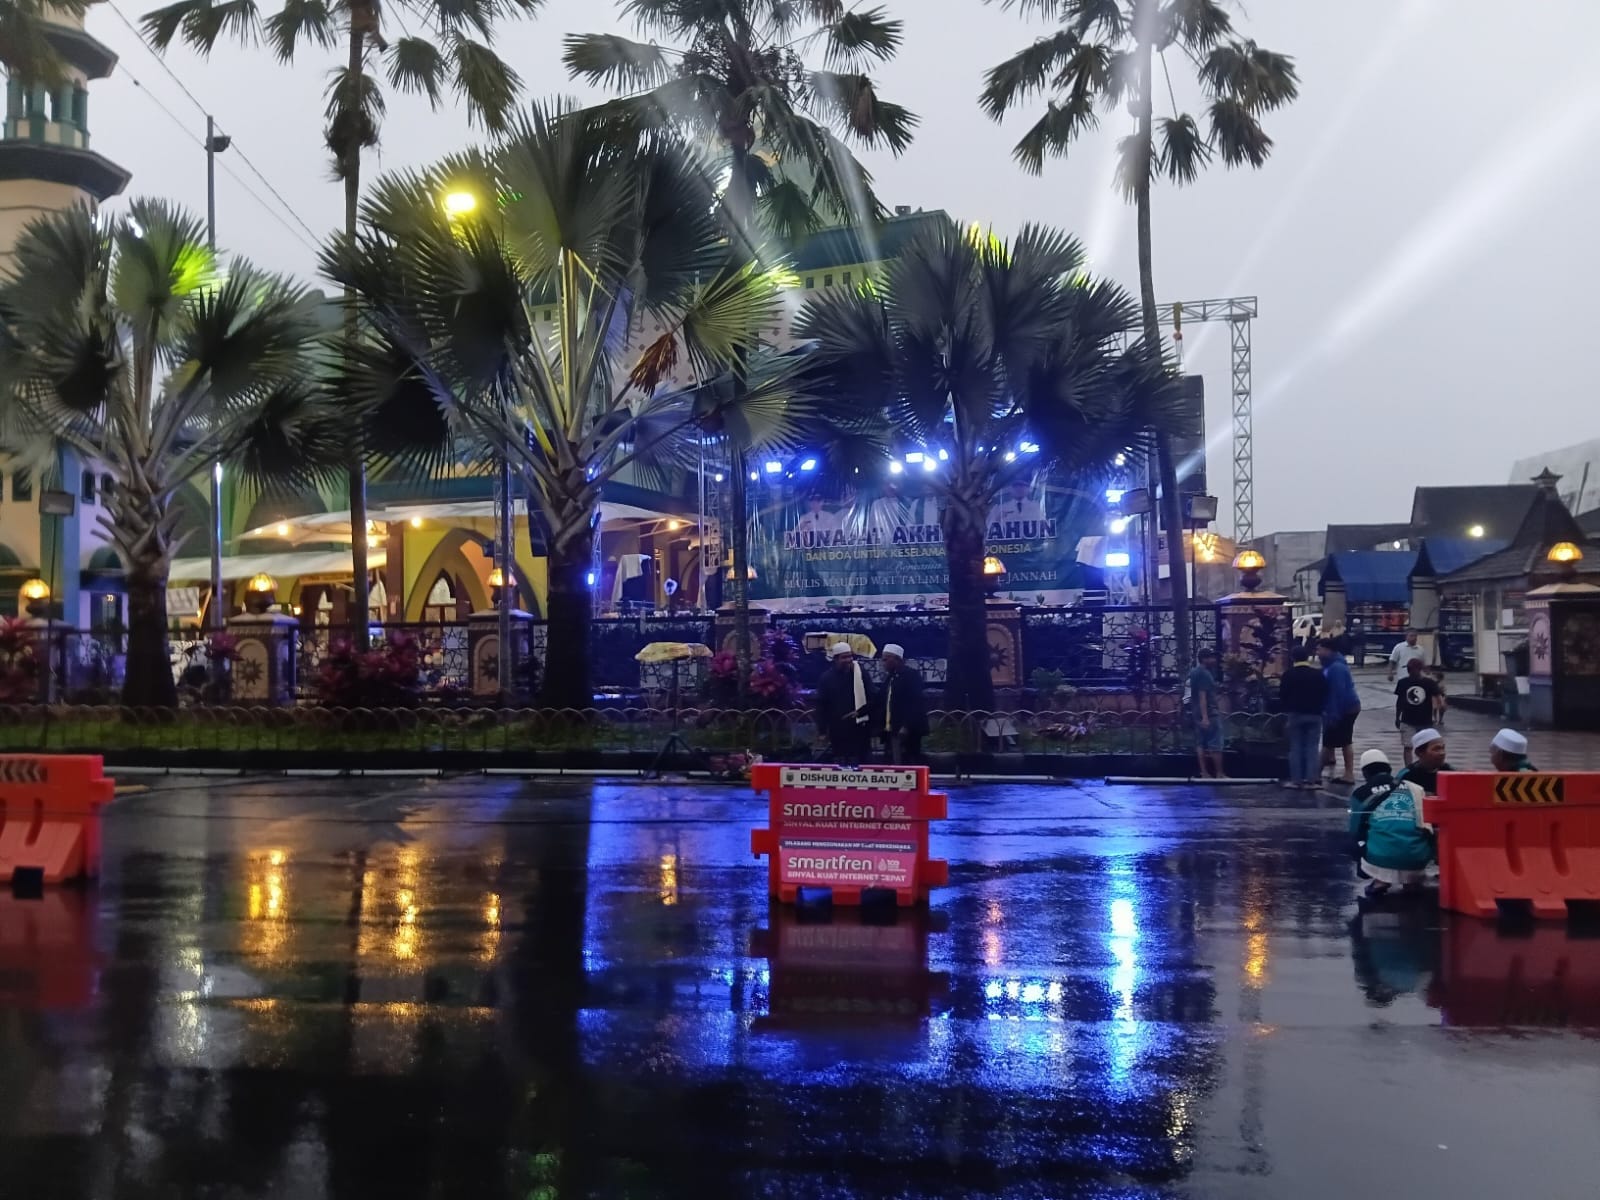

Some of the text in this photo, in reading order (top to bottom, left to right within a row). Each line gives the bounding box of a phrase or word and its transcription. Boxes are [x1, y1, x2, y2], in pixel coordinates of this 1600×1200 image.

[891, 523, 945, 544] AKH
[984, 518, 1057, 541] AHUN
[853, 549, 888, 560] UNTUK
[890, 546, 946, 558] KESELAMA
[1005, 570, 1057, 584] JANNAH
[800, 773, 898, 784] DISHUB KOTA BATU
[783, 800, 874, 818] smartfren
[839, 822, 882, 830] INTERNET
[883, 823, 912, 831] CEPAT
[787, 855, 872, 871] smartfren
[787, 871, 815, 879] SINYAL
[817, 872, 838, 880] KUAT
[839, 872, 879, 881] INTERNET
